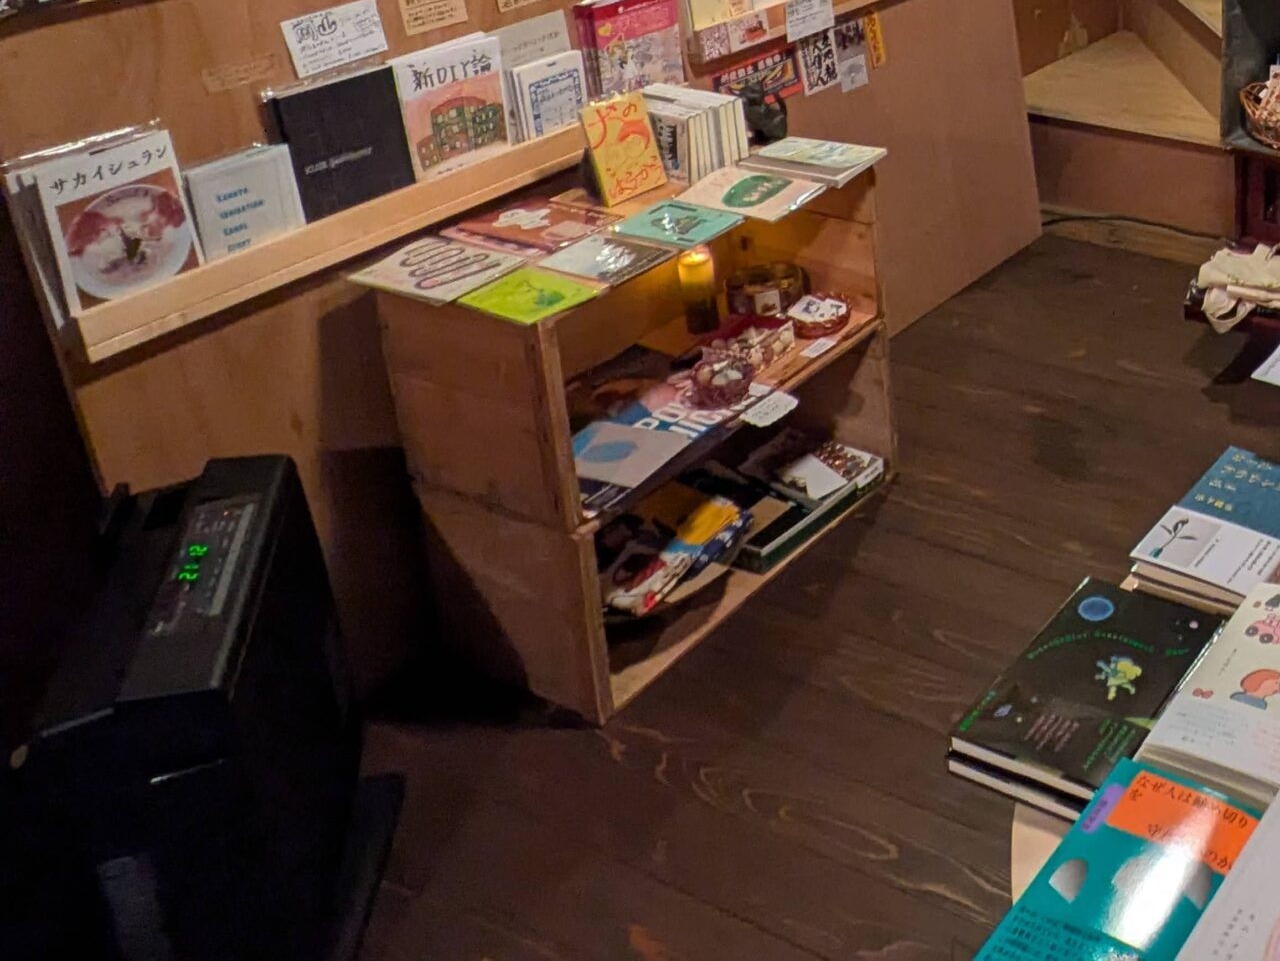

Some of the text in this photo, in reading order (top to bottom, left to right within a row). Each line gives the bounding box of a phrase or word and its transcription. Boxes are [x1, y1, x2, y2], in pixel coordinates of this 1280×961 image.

[408, 49, 492, 92] 新DIY論
[49, 144, 168, 196] サカイシュラン
